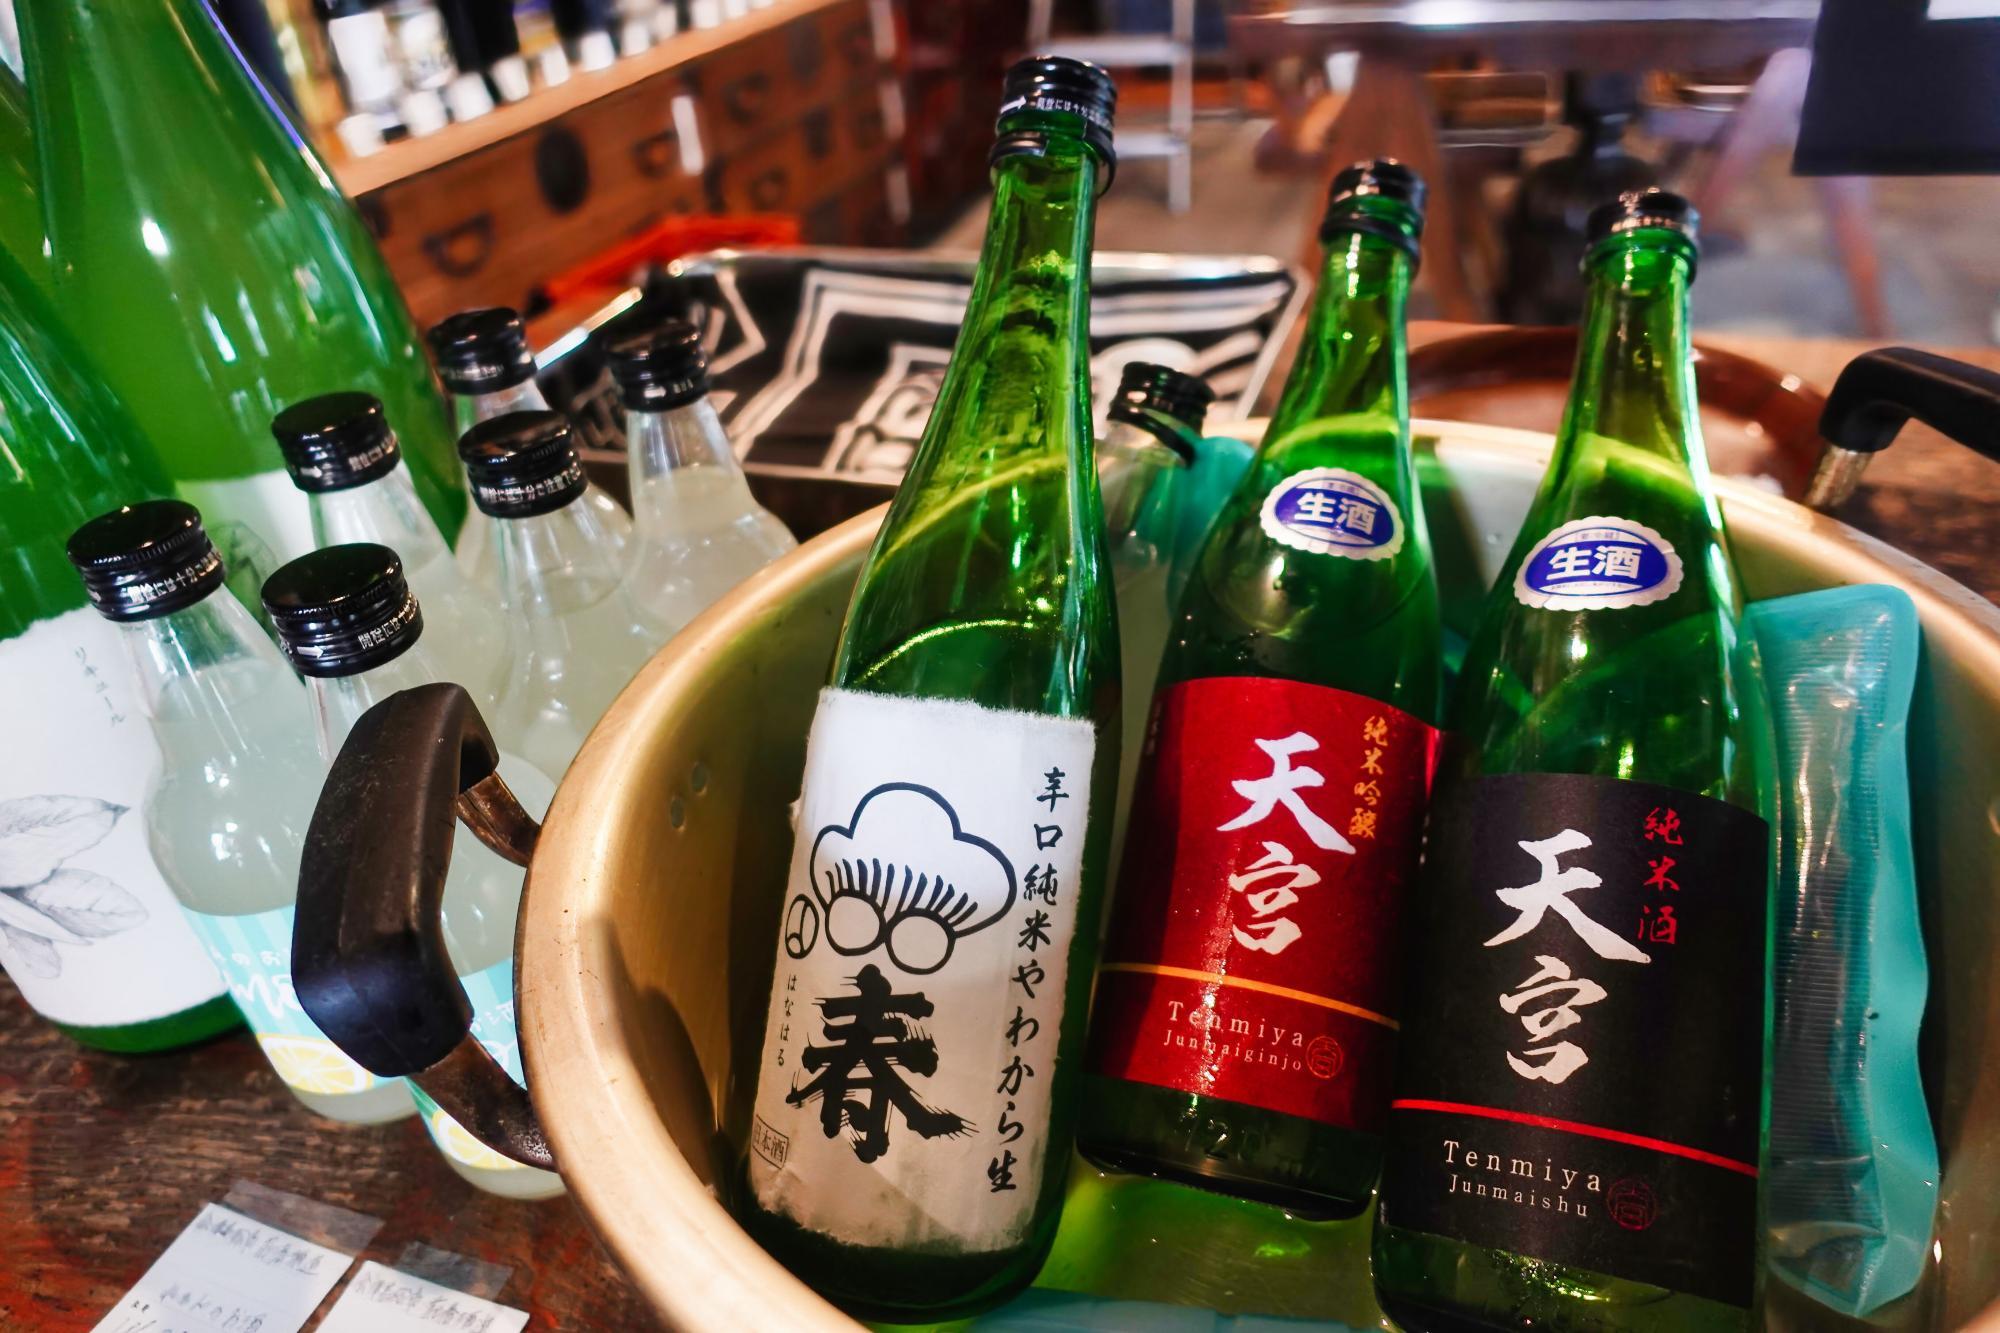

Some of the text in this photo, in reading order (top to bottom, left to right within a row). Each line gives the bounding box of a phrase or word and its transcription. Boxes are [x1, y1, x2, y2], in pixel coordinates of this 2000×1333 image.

[1293, 491, 1378, 536] 生酒
[1545, 545, 1643, 580] 生酒
[1215, 731, 1357, 956] 天宮
[1637, 806, 1684, 945] 純米酒
[986, 765, 1070, 1193] 辛口純米やわから生
[1483, 828, 1652, 1085] 天宮
[778, 972, 798, 1067] はなはる
[1163, 1029, 1303, 1072] Junmaiginjo
[1167, 1000, 1303, 1048] Tenmiya
[784, 963, 980, 1164] 春
[1443, 1139, 1601, 1192] Tenmiya
[1449, 1173, 1588, 1218] Junmaishu
